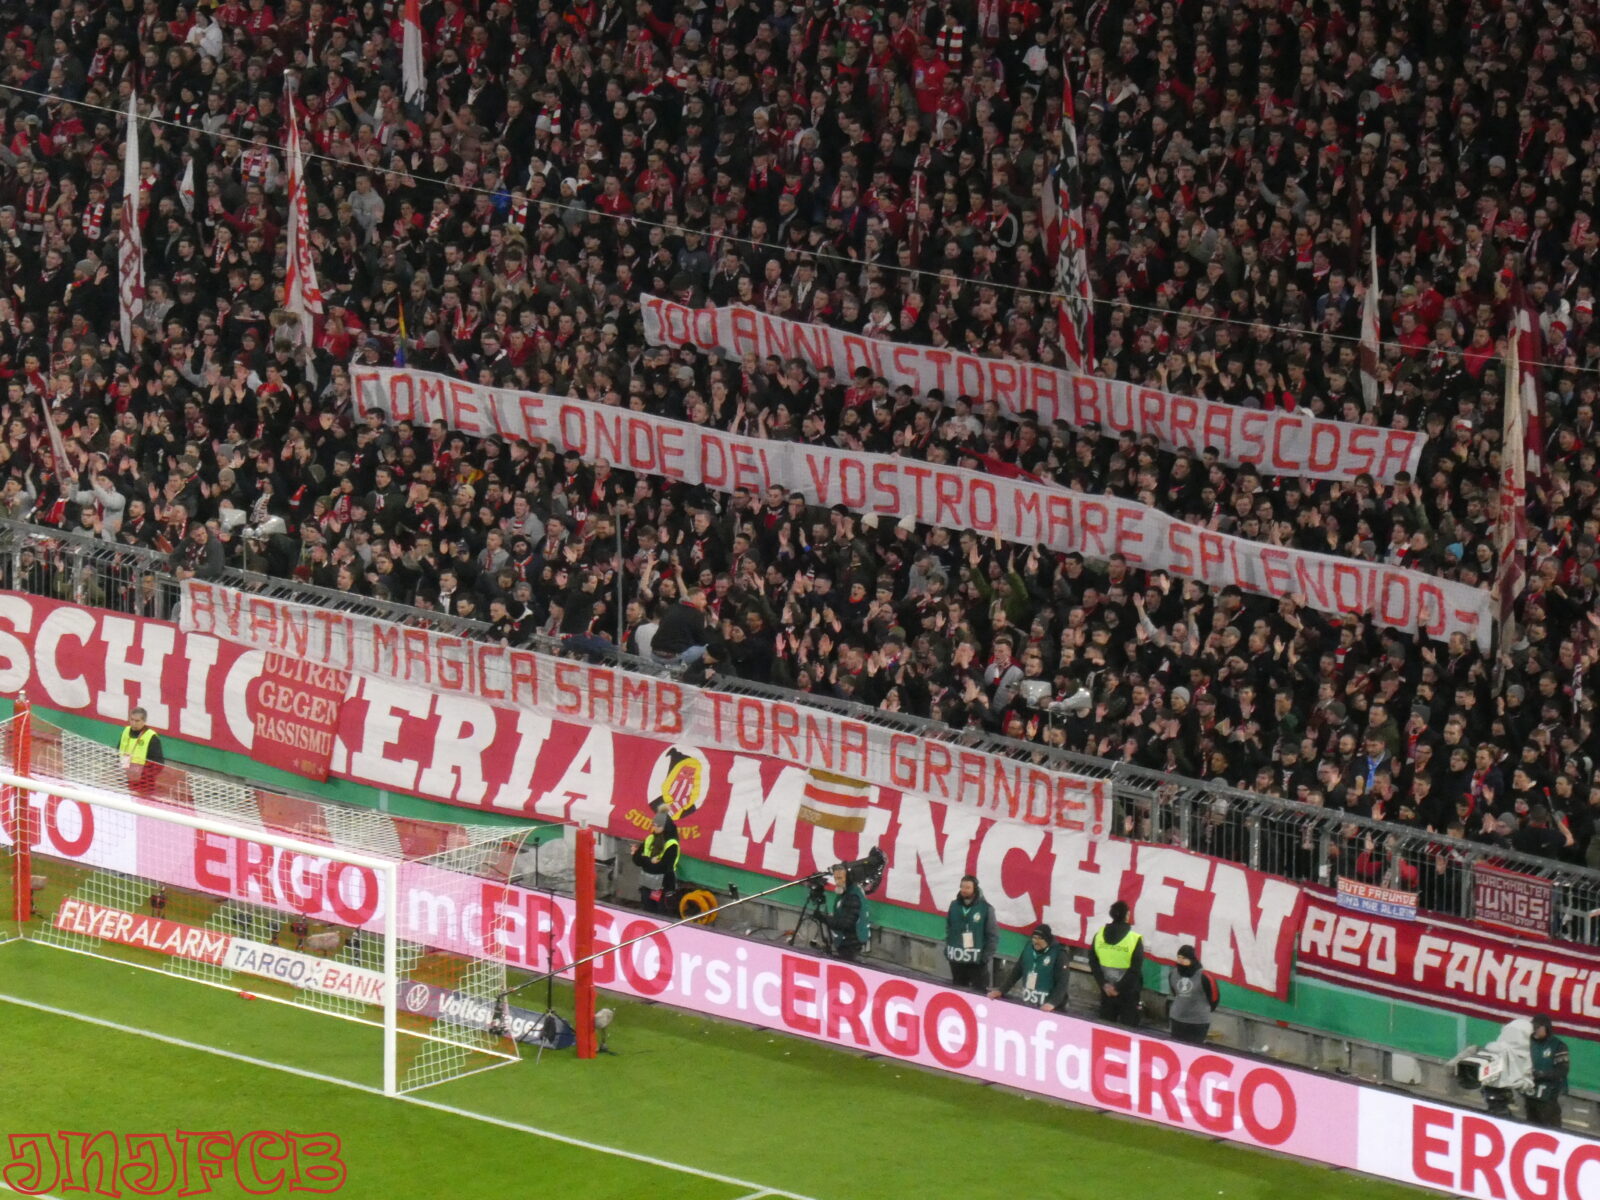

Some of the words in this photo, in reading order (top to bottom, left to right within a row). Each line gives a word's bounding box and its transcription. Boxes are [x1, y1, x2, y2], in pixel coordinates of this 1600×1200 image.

[648, 300, 717, 348] 100
[731, 307, 833, 372] ANNI
[843, 335, 883, 379] DI
[895, 346, 1060, 420] STORIA
[1073, 376, 1415, 474] BURRASCOSA
[355, 372, 480, 432] COME
[489, 394, 548, 445] LE
[559, 404, 684, 477] ONDE
[806, 454, 997, 531] VOSTRO
[1015, 489, 1143, 563] MARE
[189, 582, 353, 670] AVANTI
[373, 623, 538, 706] MAGICA
[555, 663, 683, 734] SAMB
[704, 691, 868, 776] TORNA
[890, 733, 1106, 836] GRANDE!
[258, 680, 338, 726] GEGEN
[265, 652, 348, 694] ULTRAS
[194, 829, 379, 924] ERGO
[1475, 885, 1550, 920] JUNGS!
[57, 902, 225, 963] FLYERALARM
[481, 883, 673, 996] ERGO
[947, 945, 981, 962] HOST
[781, 954, 978, 1069] ERGO
[1091, 1028, 1297, 1145] ERGO
